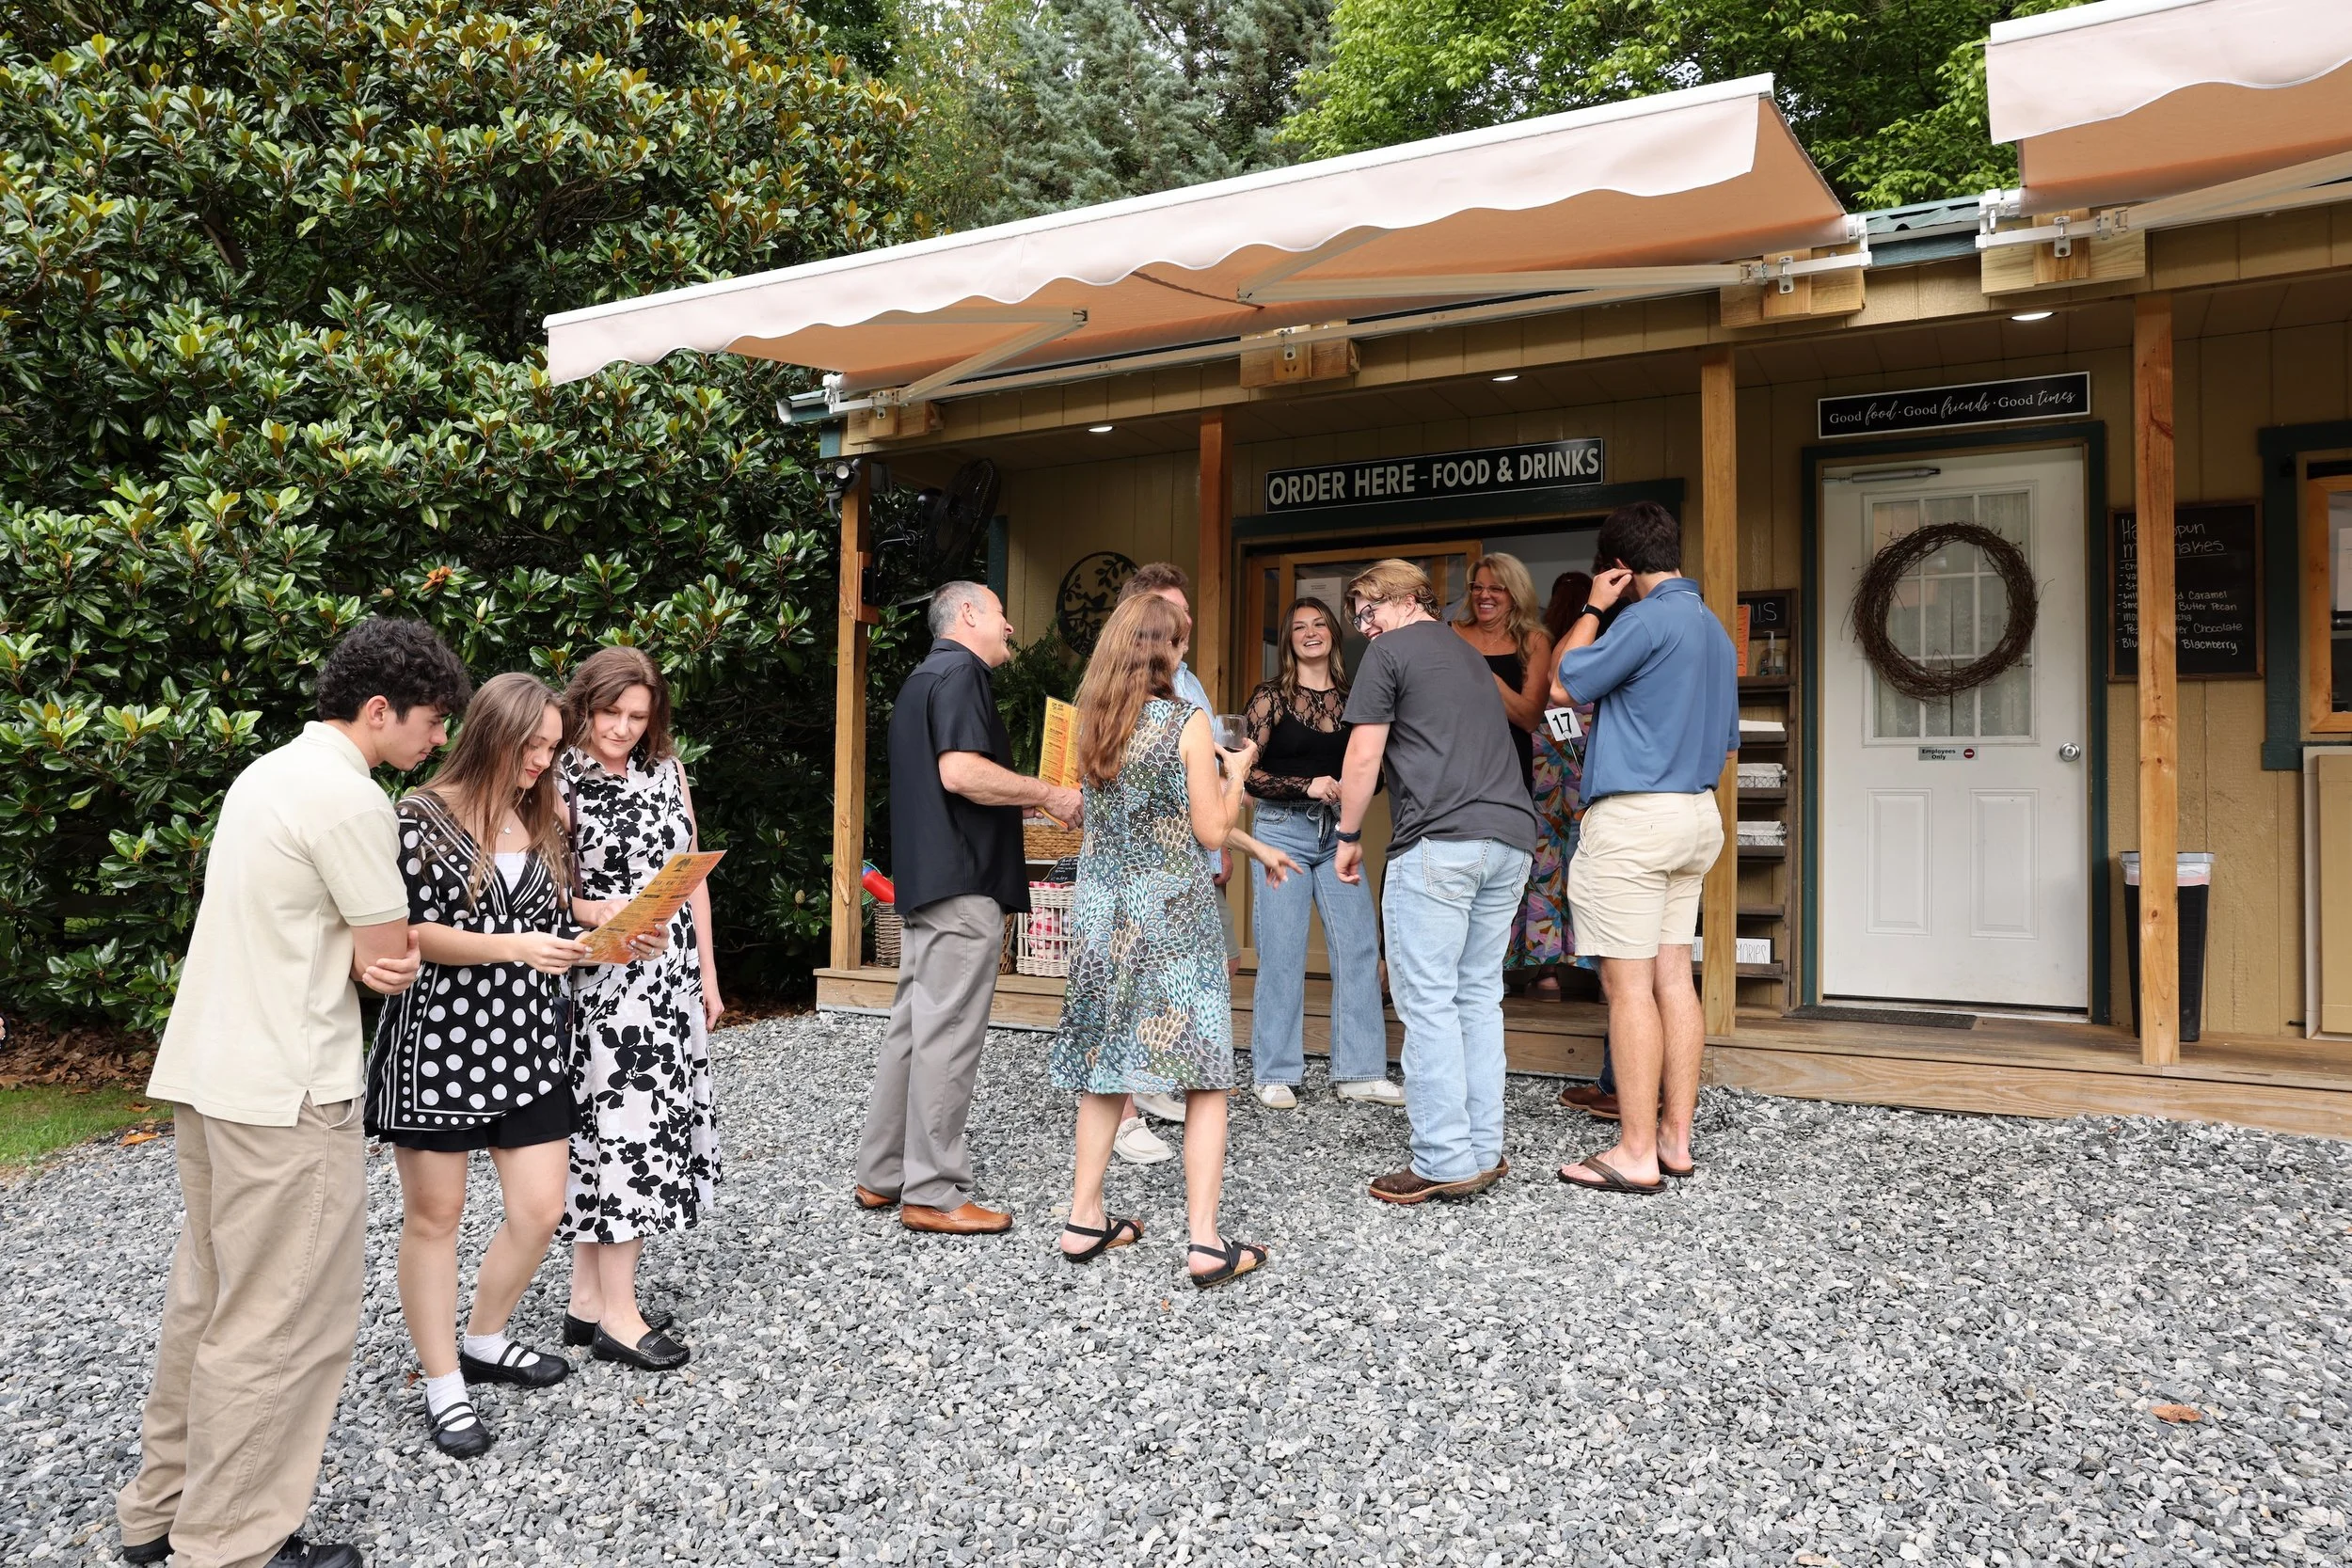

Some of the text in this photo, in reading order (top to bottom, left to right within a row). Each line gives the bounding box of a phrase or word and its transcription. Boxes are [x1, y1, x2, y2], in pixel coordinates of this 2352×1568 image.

[1829, 389, 2076, 426] Good food Good friends Good times
[1268, 470, 1346, 505] ORDER
[1432, 458, 1490, 489] FOOD
[1496, 456, 1514, 483] &
[1519, 447, 1599, 481] DRINKS
[2188, 590, 2228, 600] Caramel
[2178, 601, 2207, 610] Butter
[2211, 602, 2237, 611] Pecan
[2193, 623, 2244, 634] Chocolate
[1552, 712, 1572, 736] 17
